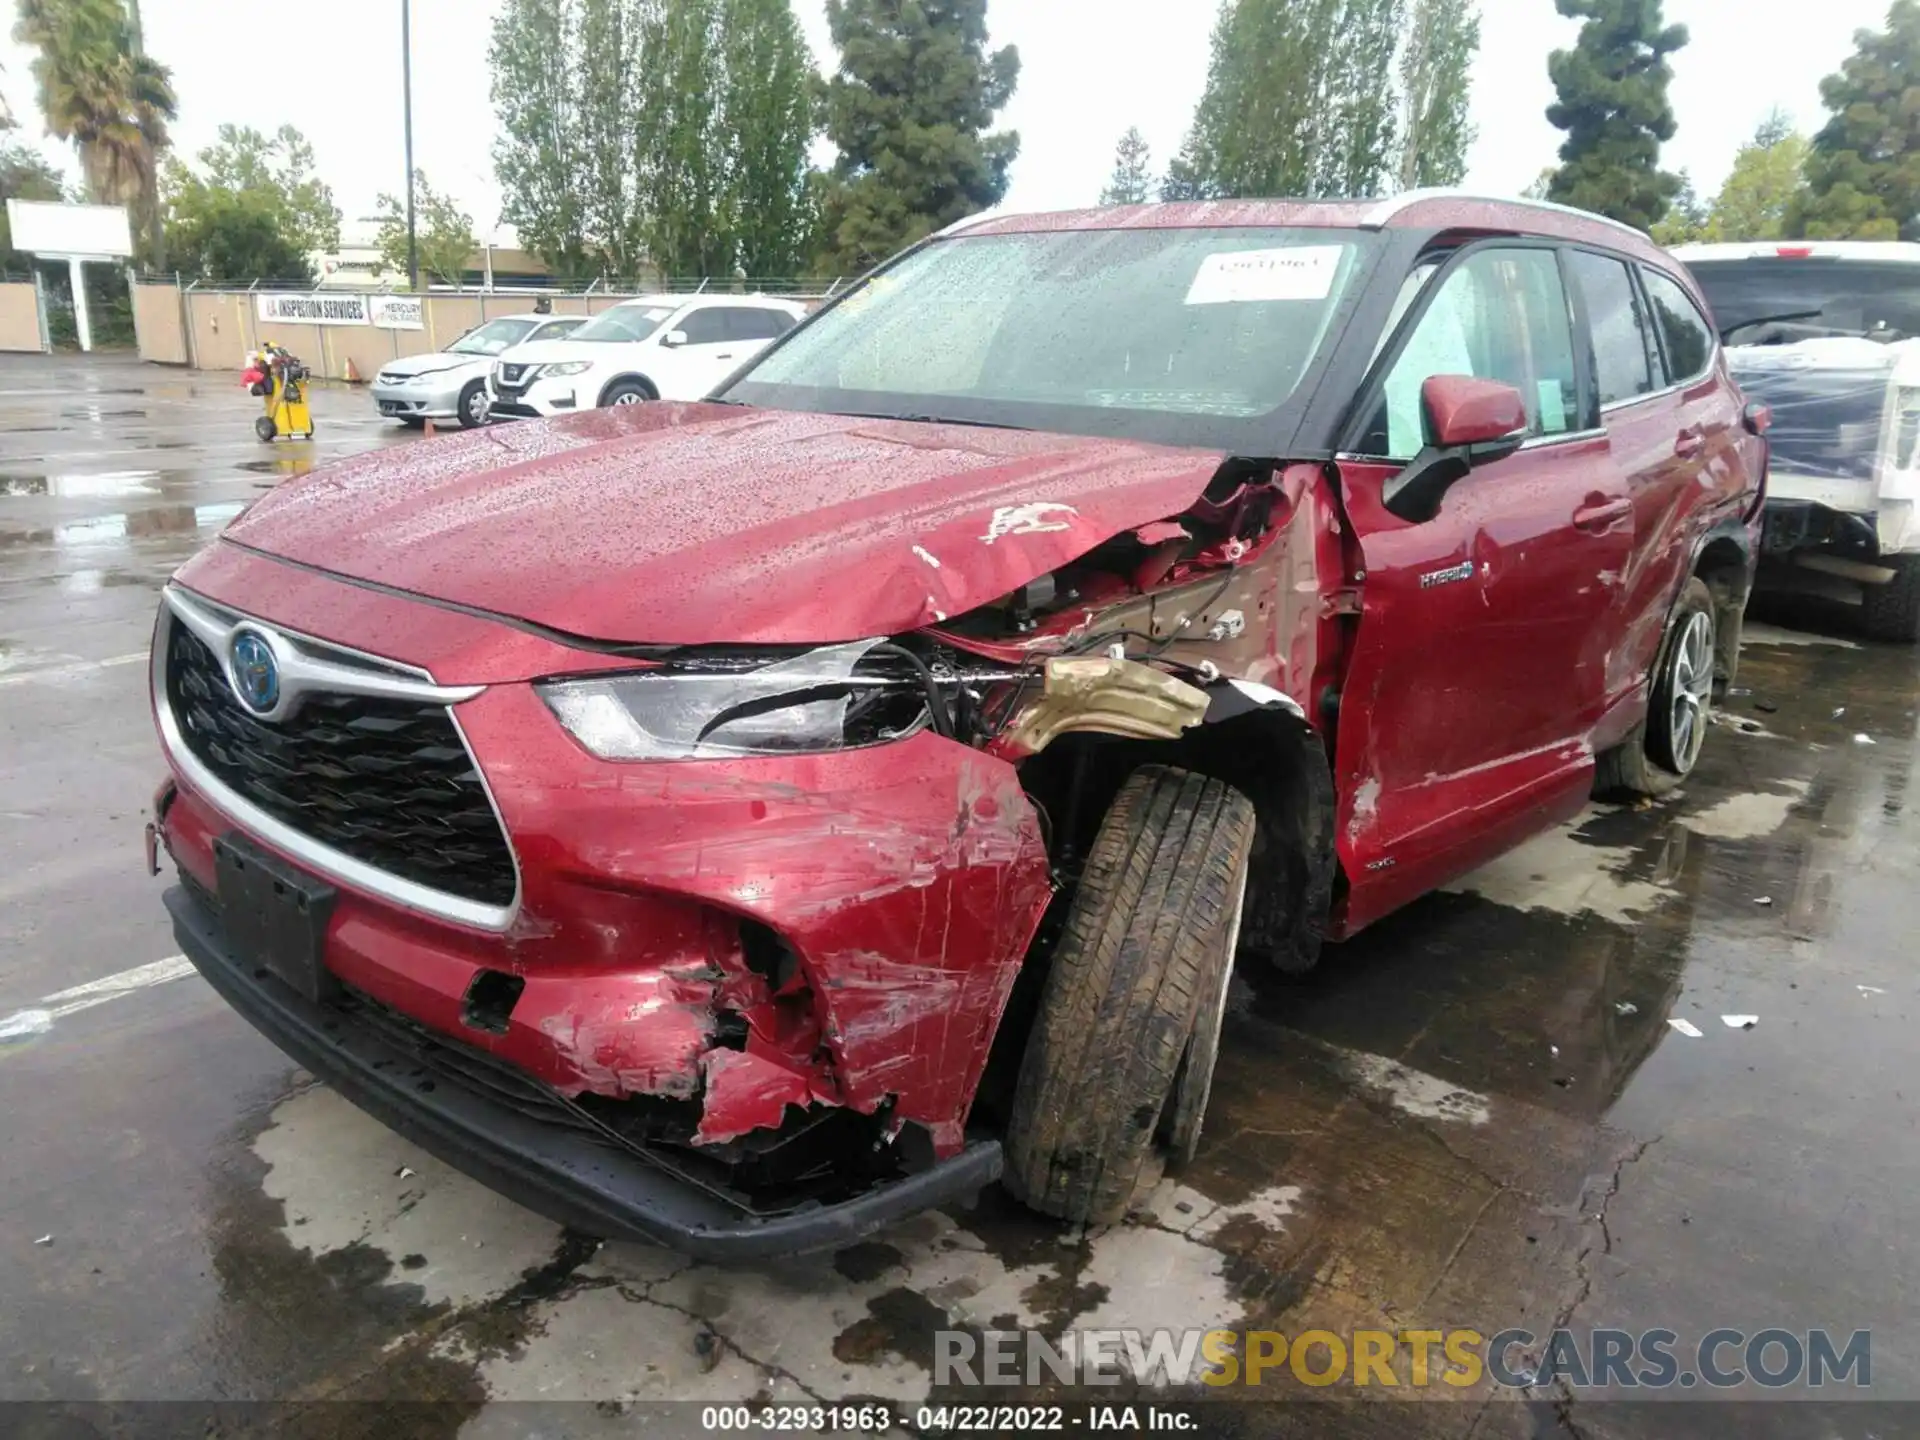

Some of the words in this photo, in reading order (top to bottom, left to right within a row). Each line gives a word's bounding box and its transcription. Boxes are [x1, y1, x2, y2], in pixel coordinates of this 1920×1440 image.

[323, 301, 364, 320] SERVICES
[384, 303, 420, 314] MERCURY
[1419, 565, 1469, 589] HYBRID
